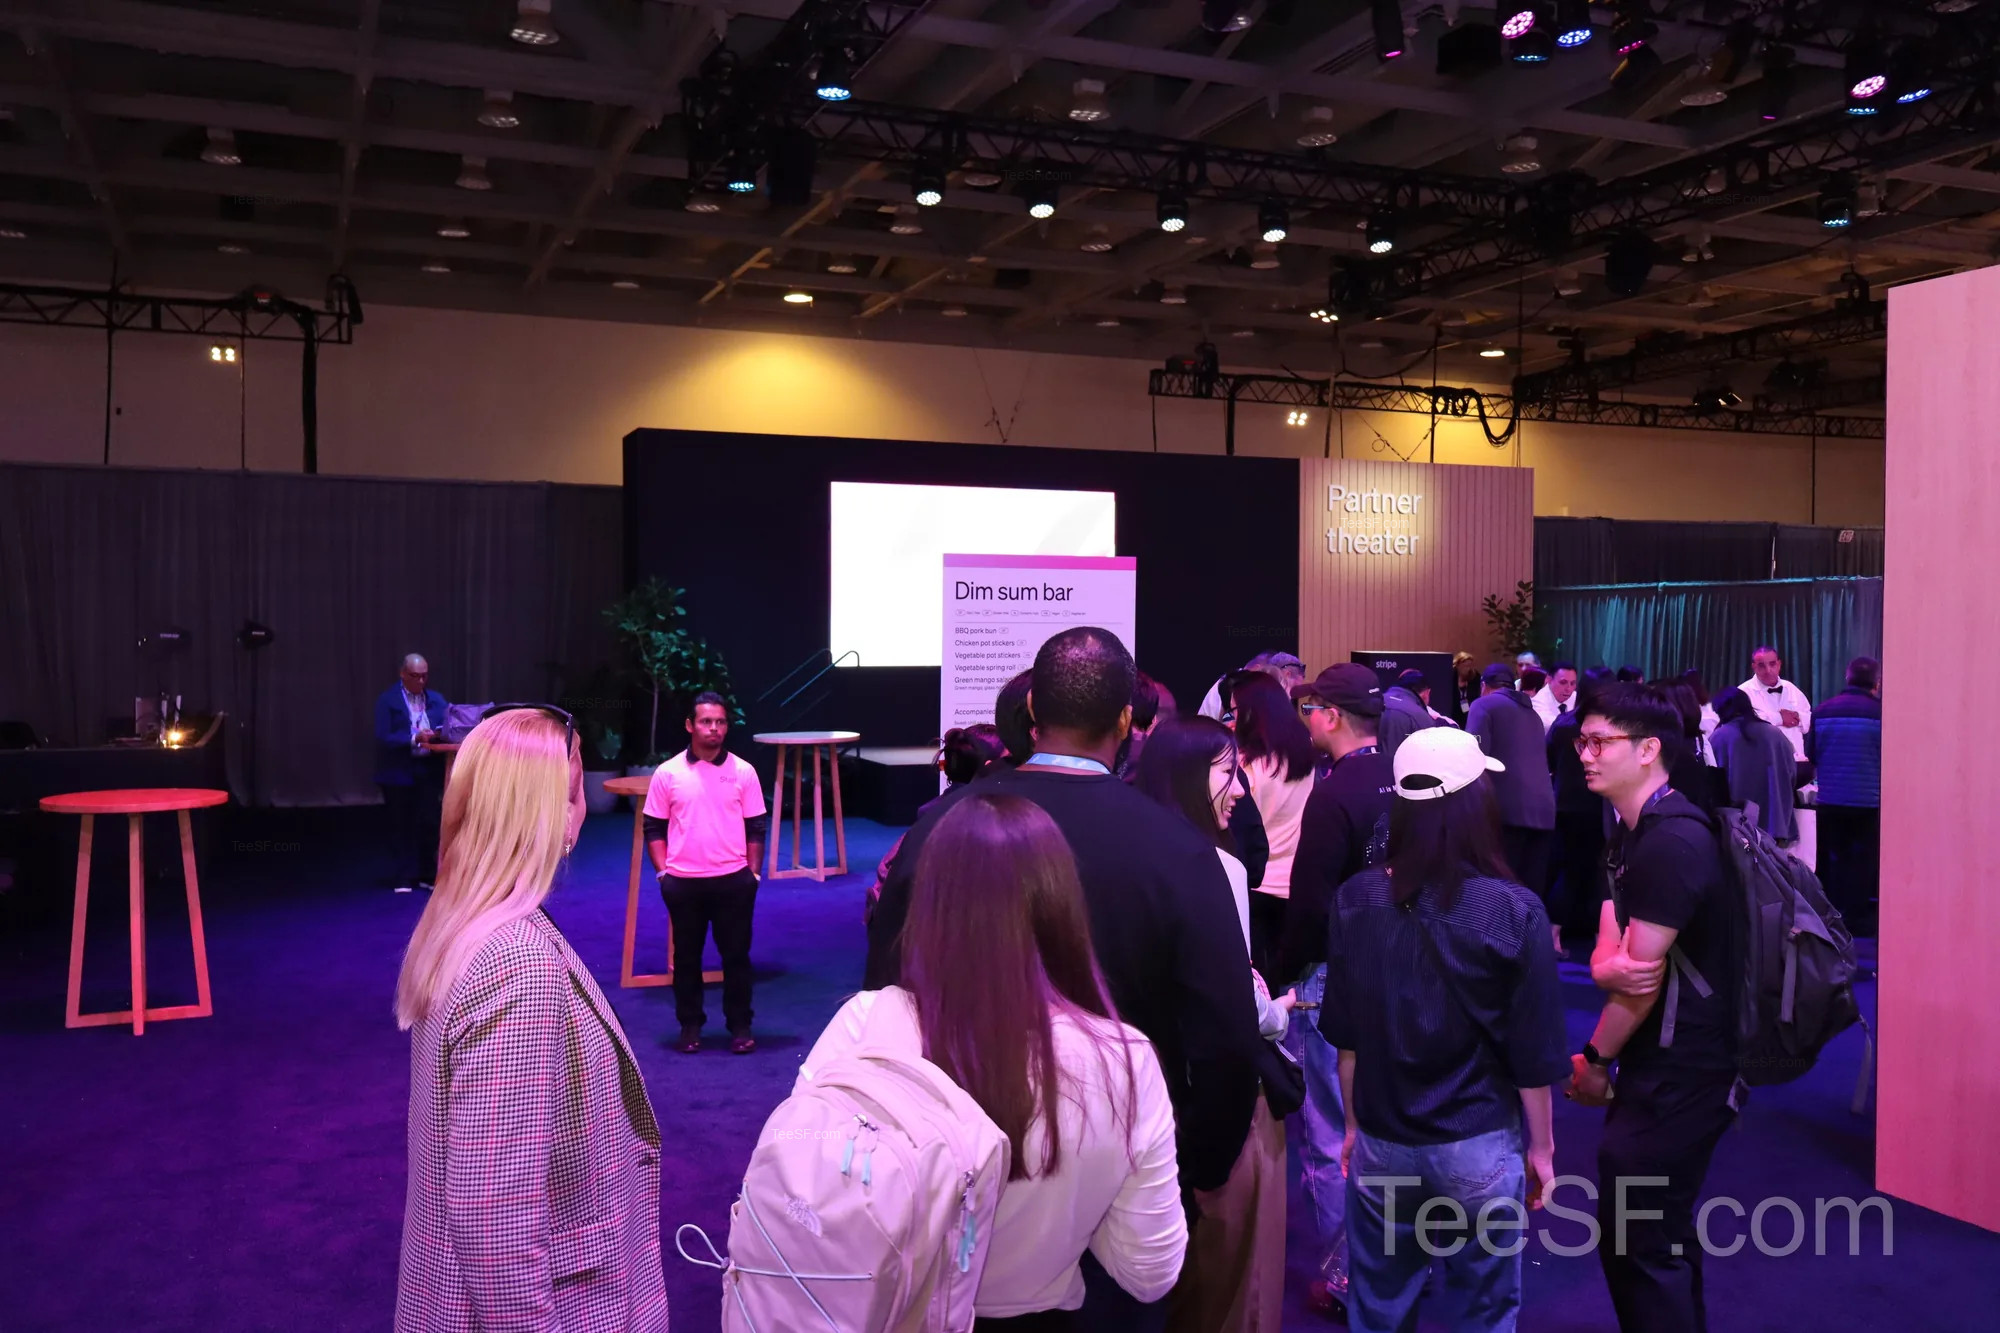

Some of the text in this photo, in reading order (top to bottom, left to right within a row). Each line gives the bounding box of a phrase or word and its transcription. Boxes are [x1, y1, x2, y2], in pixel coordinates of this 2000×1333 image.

[1327, 484, 1422, 514] Partner
[1325, 527, 1419, 555] theater
[955, 581, 1073, 601] Dim sum bar
[955, 627, 969, 635] BBQ
[970, 627, 984, 635] pork
[955, 652, 985, 660] Vegetable
[986, 652, 997, 660] pot
[954, 664, 985, 672] Vegetable
[986, 664, 1006, 672] spring
[1375, 660, 1397, 670] stripe
